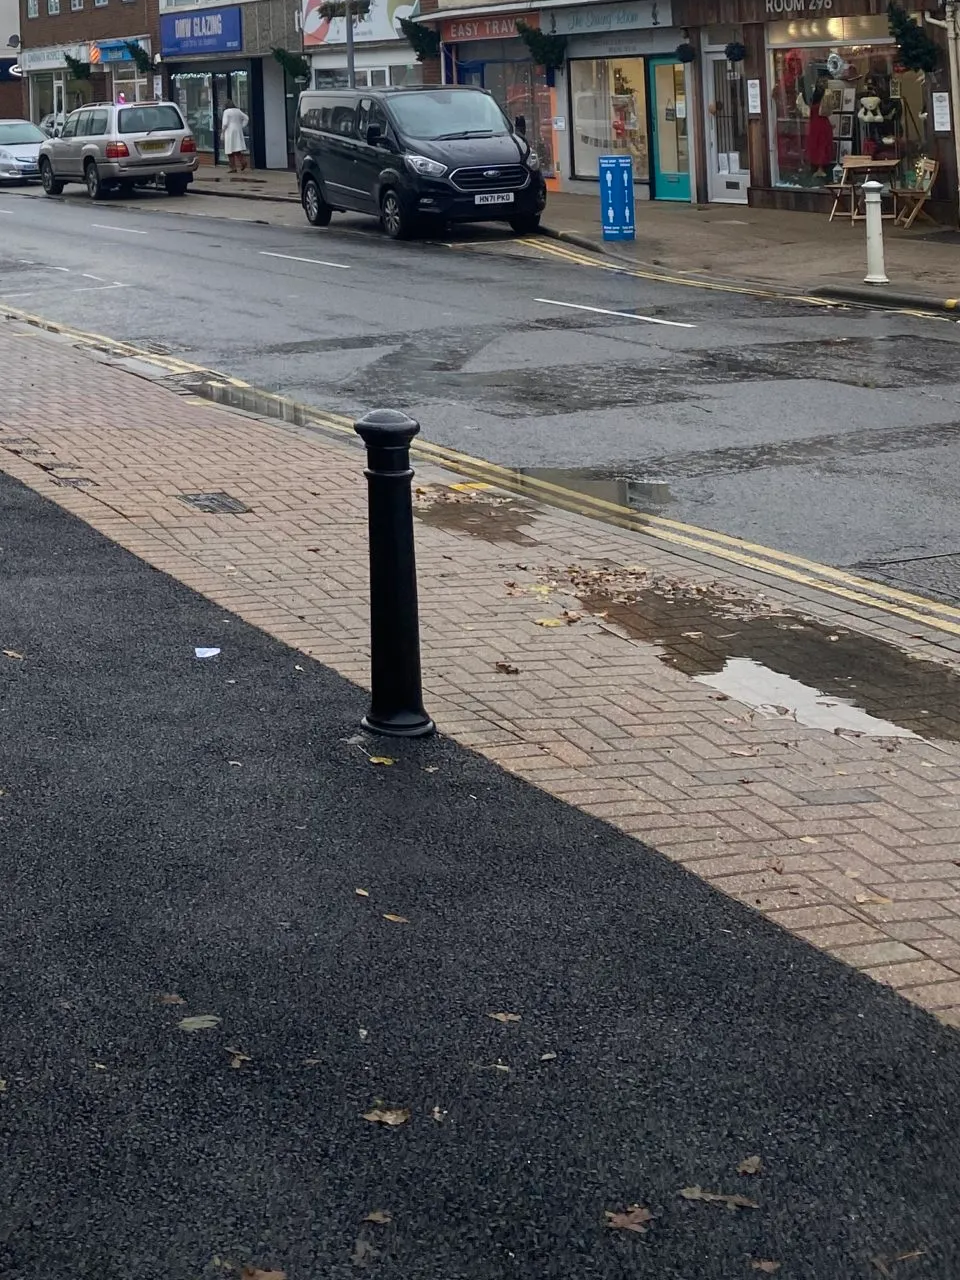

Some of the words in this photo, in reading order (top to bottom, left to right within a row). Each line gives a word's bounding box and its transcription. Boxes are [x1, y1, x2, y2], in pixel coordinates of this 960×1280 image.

[193, 14, 222, 36] GLAZING
[451, 23, 480, 37] EASY
[485, 18, 528, 35] TRAV
[480, 195, 495, 203] HN71
